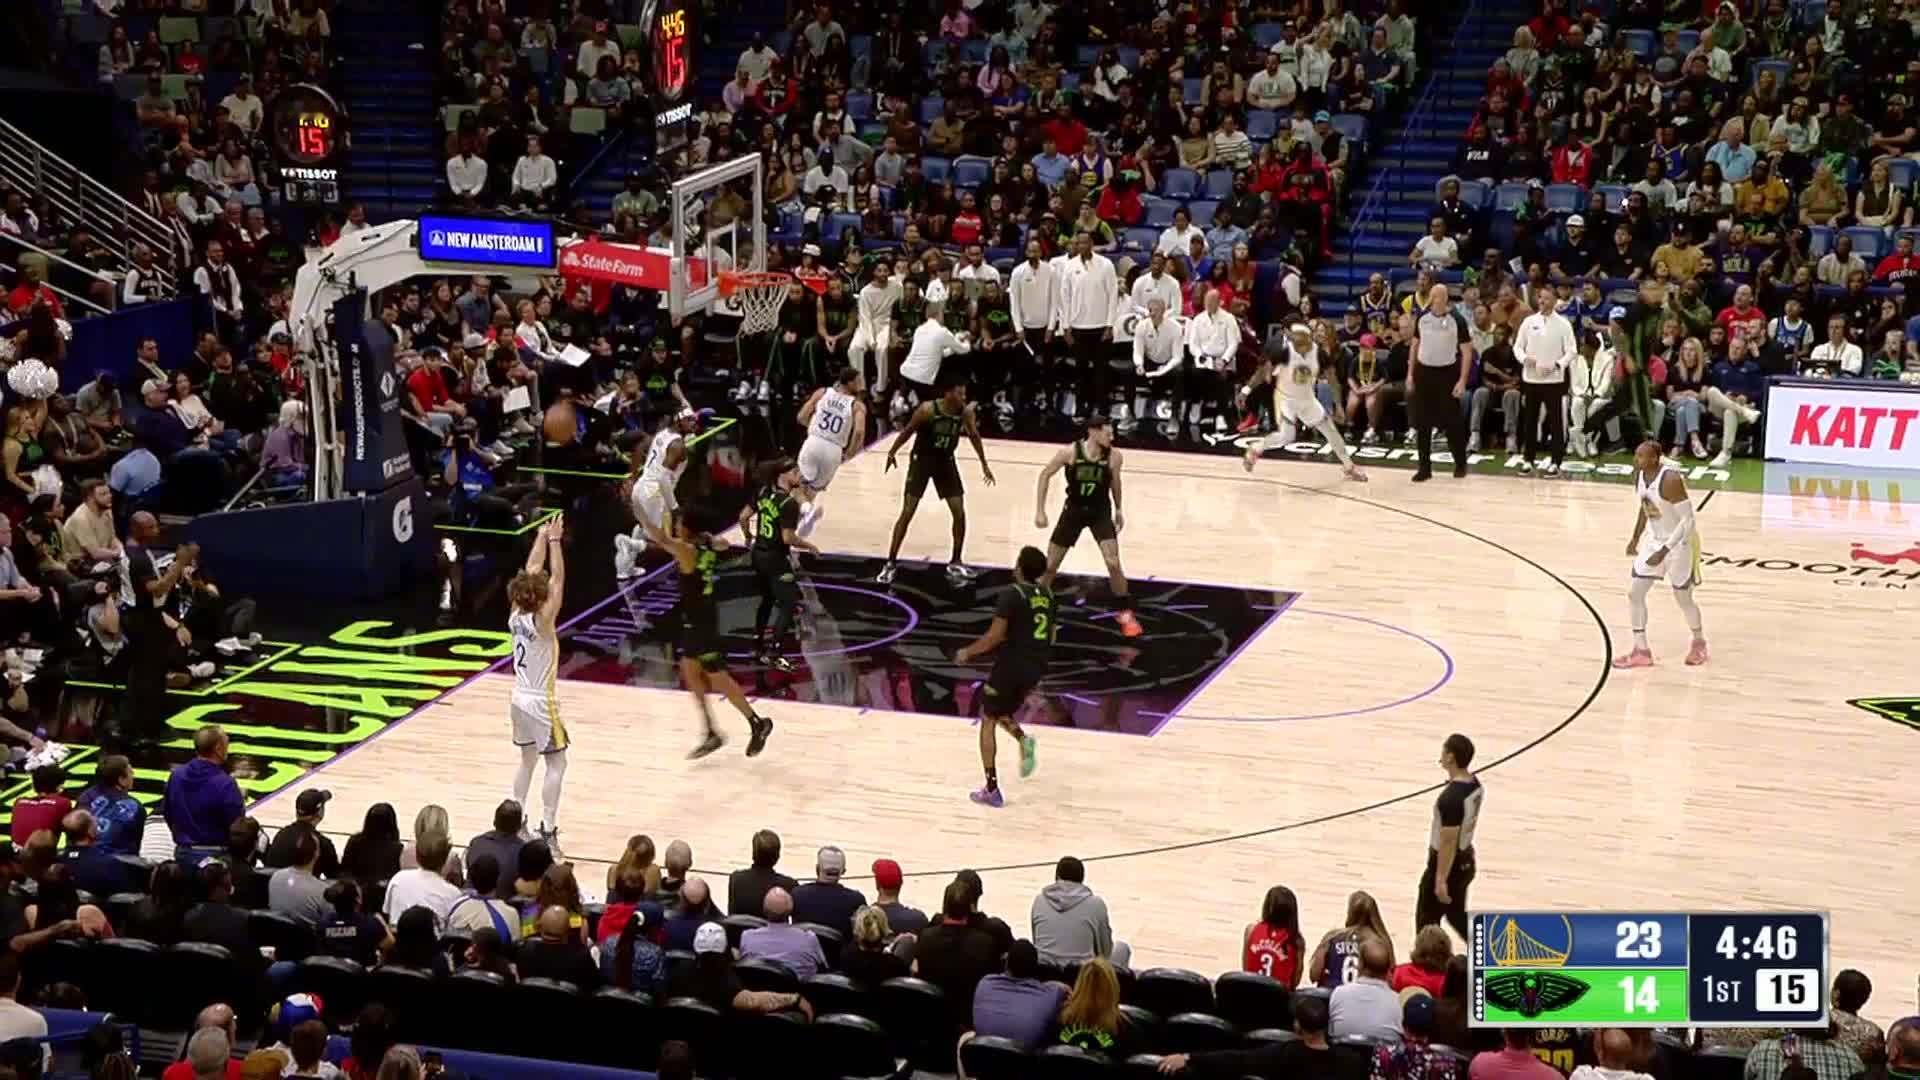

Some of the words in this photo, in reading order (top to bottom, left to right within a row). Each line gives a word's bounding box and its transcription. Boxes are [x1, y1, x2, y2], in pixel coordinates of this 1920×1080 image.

[666, 38, 685, 88] 15
[298, 127, 324, 153] 15
[296, 168, 337, 180] TISSOT
[819, 410, 843, 434] 30
[1790, 405, 1920, 450] KATT
[1503, 453, 1731, 481] Heath
[1080, 482, 1097, 497] 17
[760, 511, 774, 539] 15
[1033, 612, 1049, 640] 2
[516, 642, 528, 669] 2
[1259, 953, 1273, 977] 3
